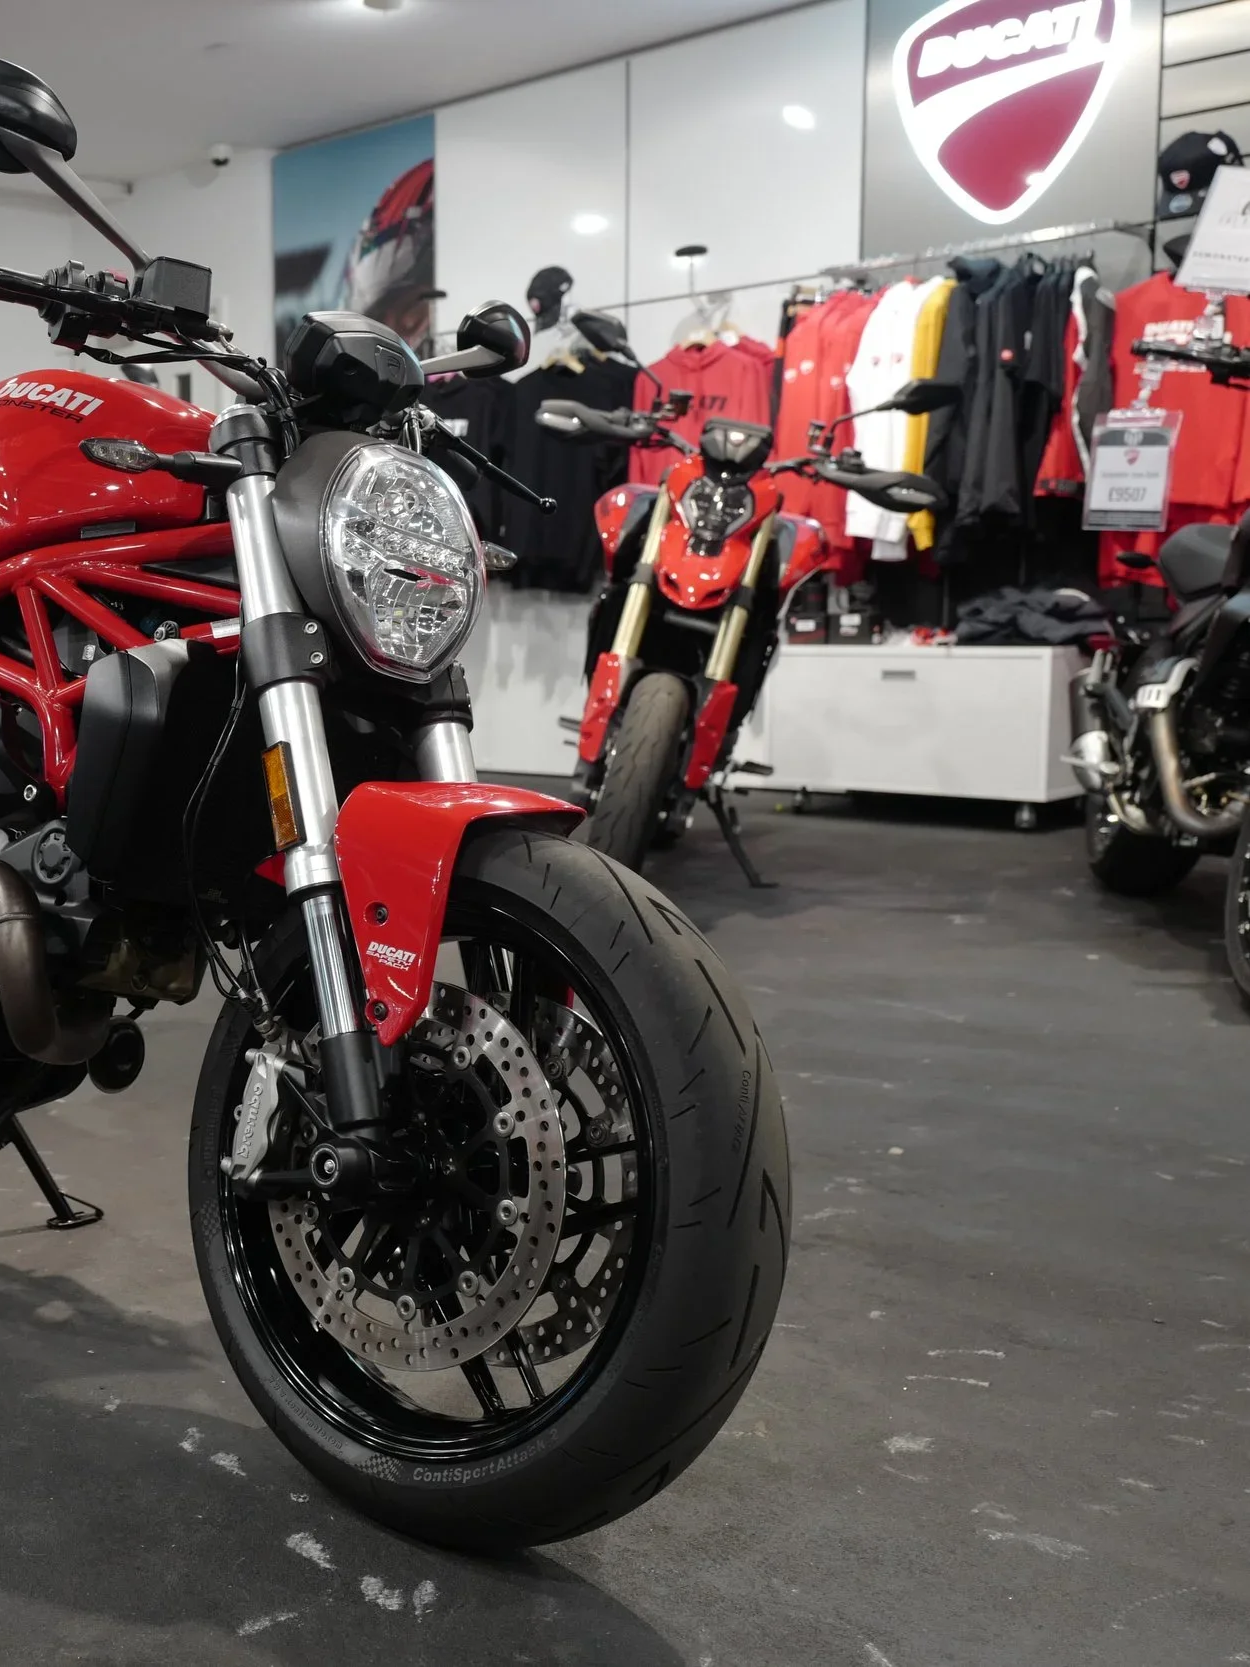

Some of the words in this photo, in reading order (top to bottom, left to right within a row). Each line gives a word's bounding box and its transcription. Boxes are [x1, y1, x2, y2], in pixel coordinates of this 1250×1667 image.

[916, 0, 1102, 78] DUCATI
[365, 950, 411, 966] SAFETY
[368, 941, 417, 963] DUCATI
[236, 1082, 263, 1159] brembo
[412, 1437, 547, 1484] ContiSportAttack
